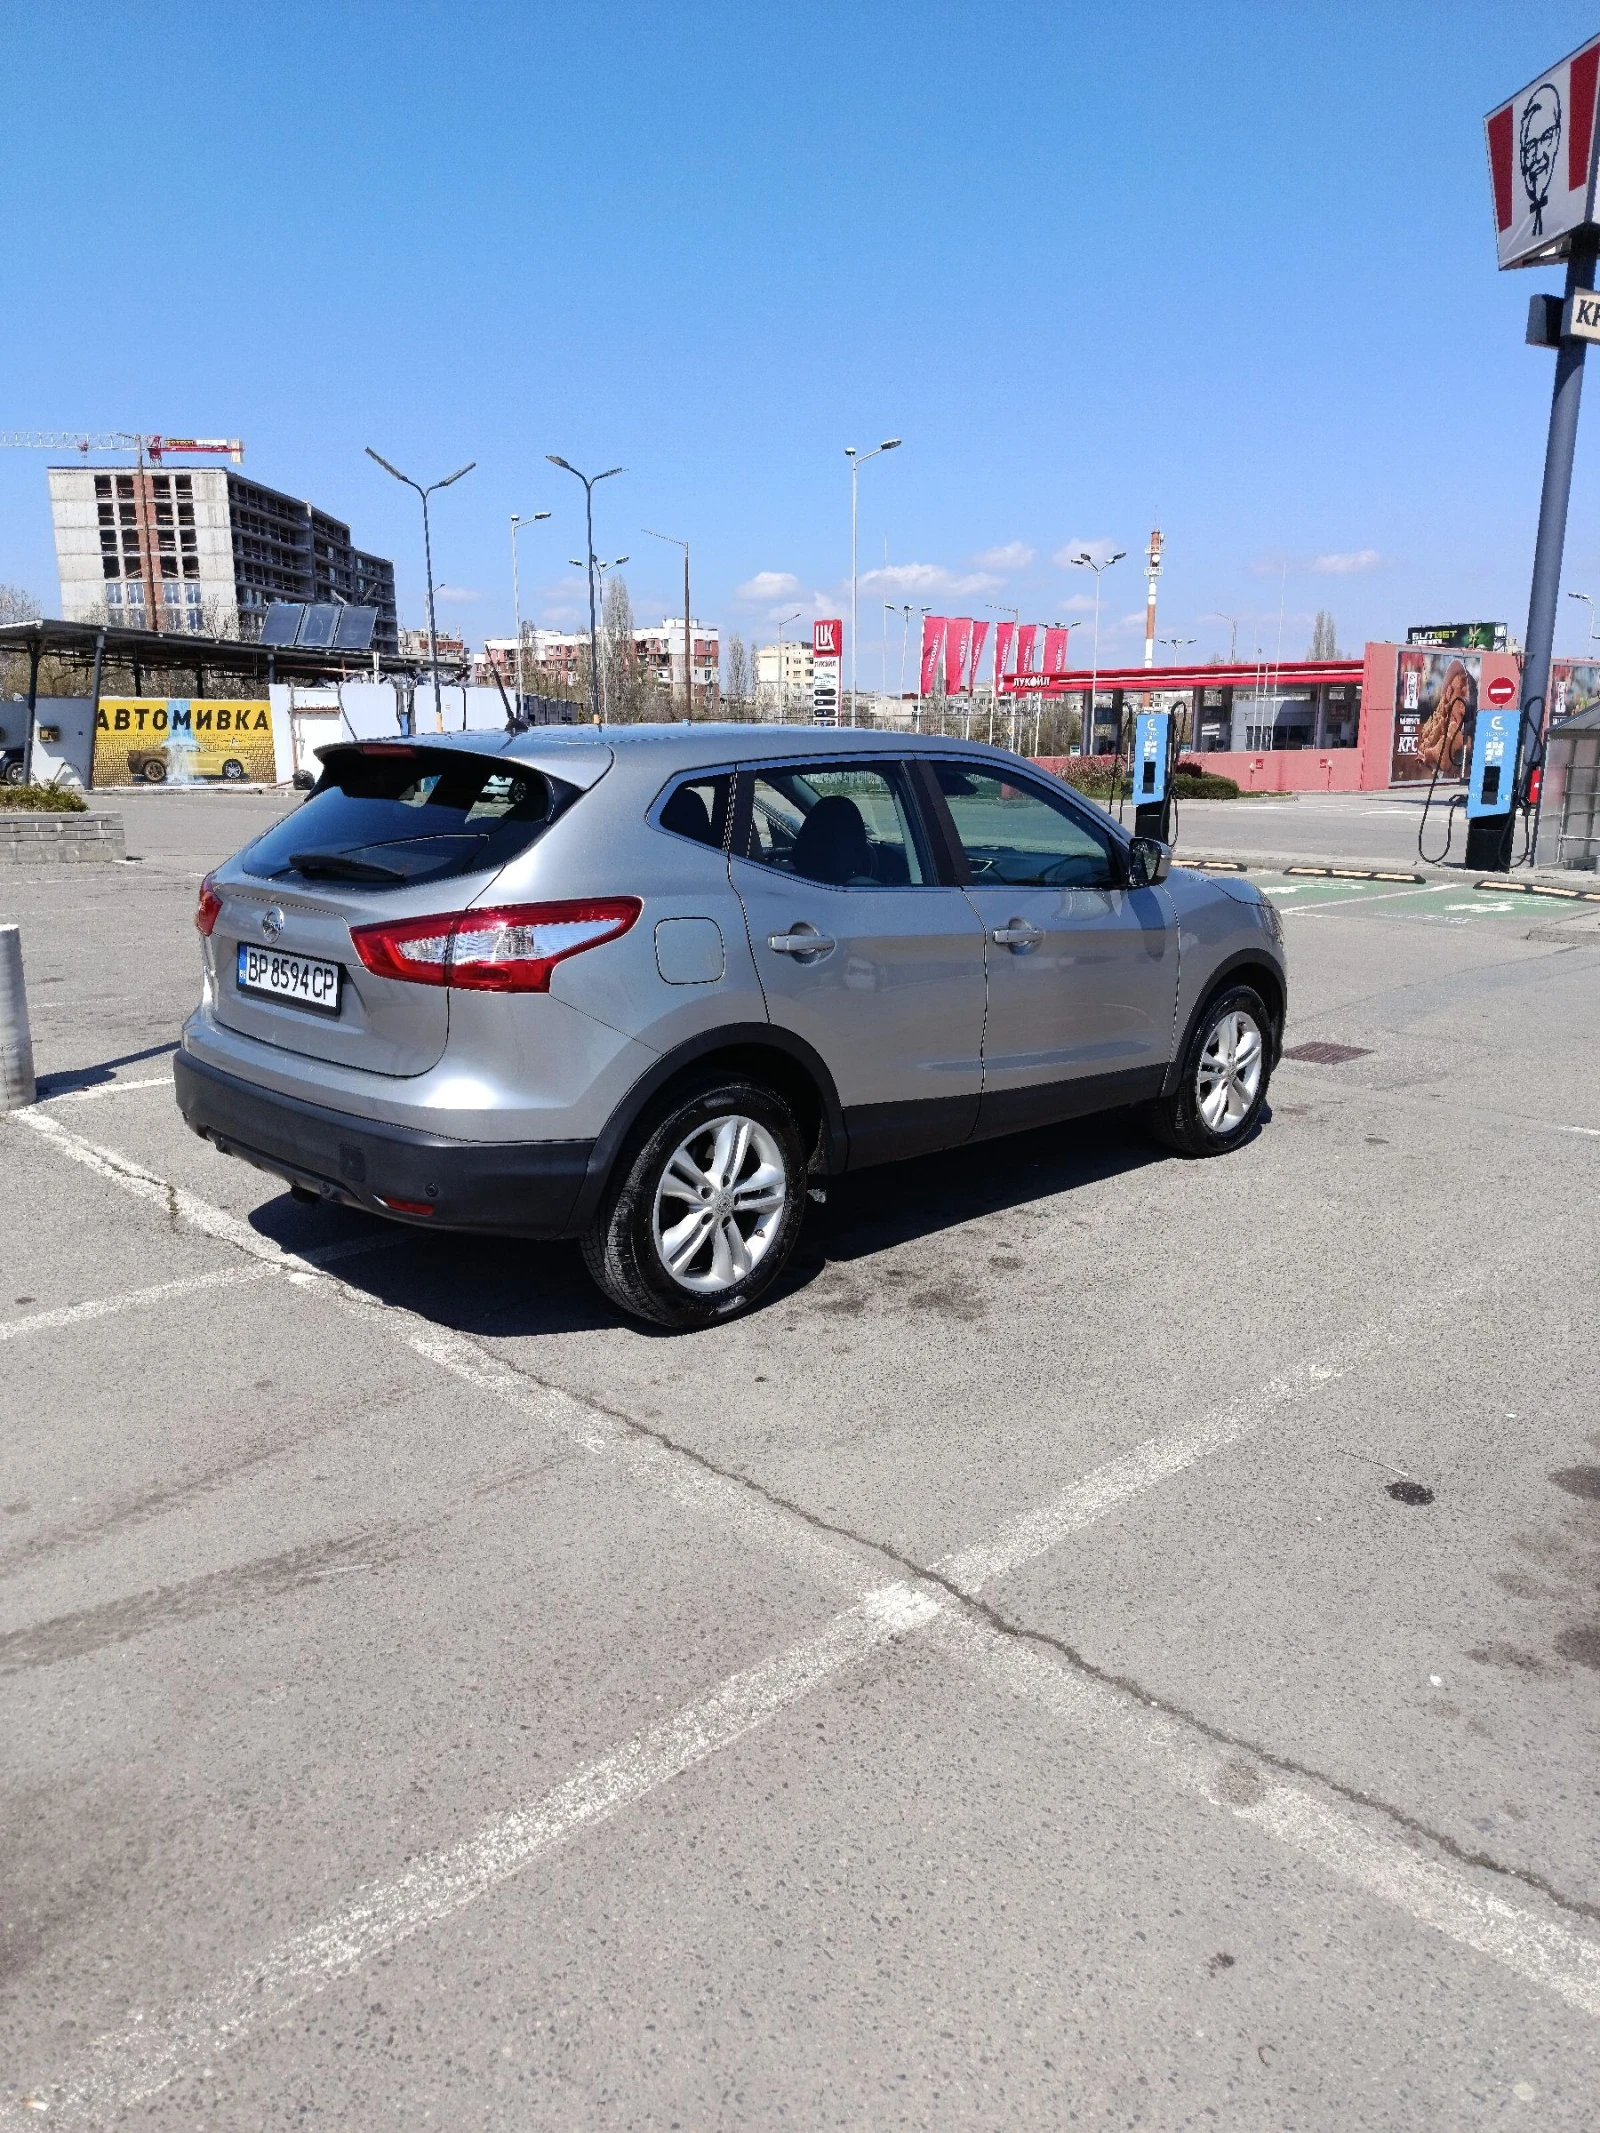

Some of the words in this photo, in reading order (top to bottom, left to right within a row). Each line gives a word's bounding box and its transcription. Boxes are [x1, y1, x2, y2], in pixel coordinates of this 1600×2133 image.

[1013, 675, 1050, 688] ЛУКОЙЛ
[97, 708, 270, 731] АВТОМИВКА
[1397, 736, 1419, 753] KFC
[271, 957, 309, 996] 8594
